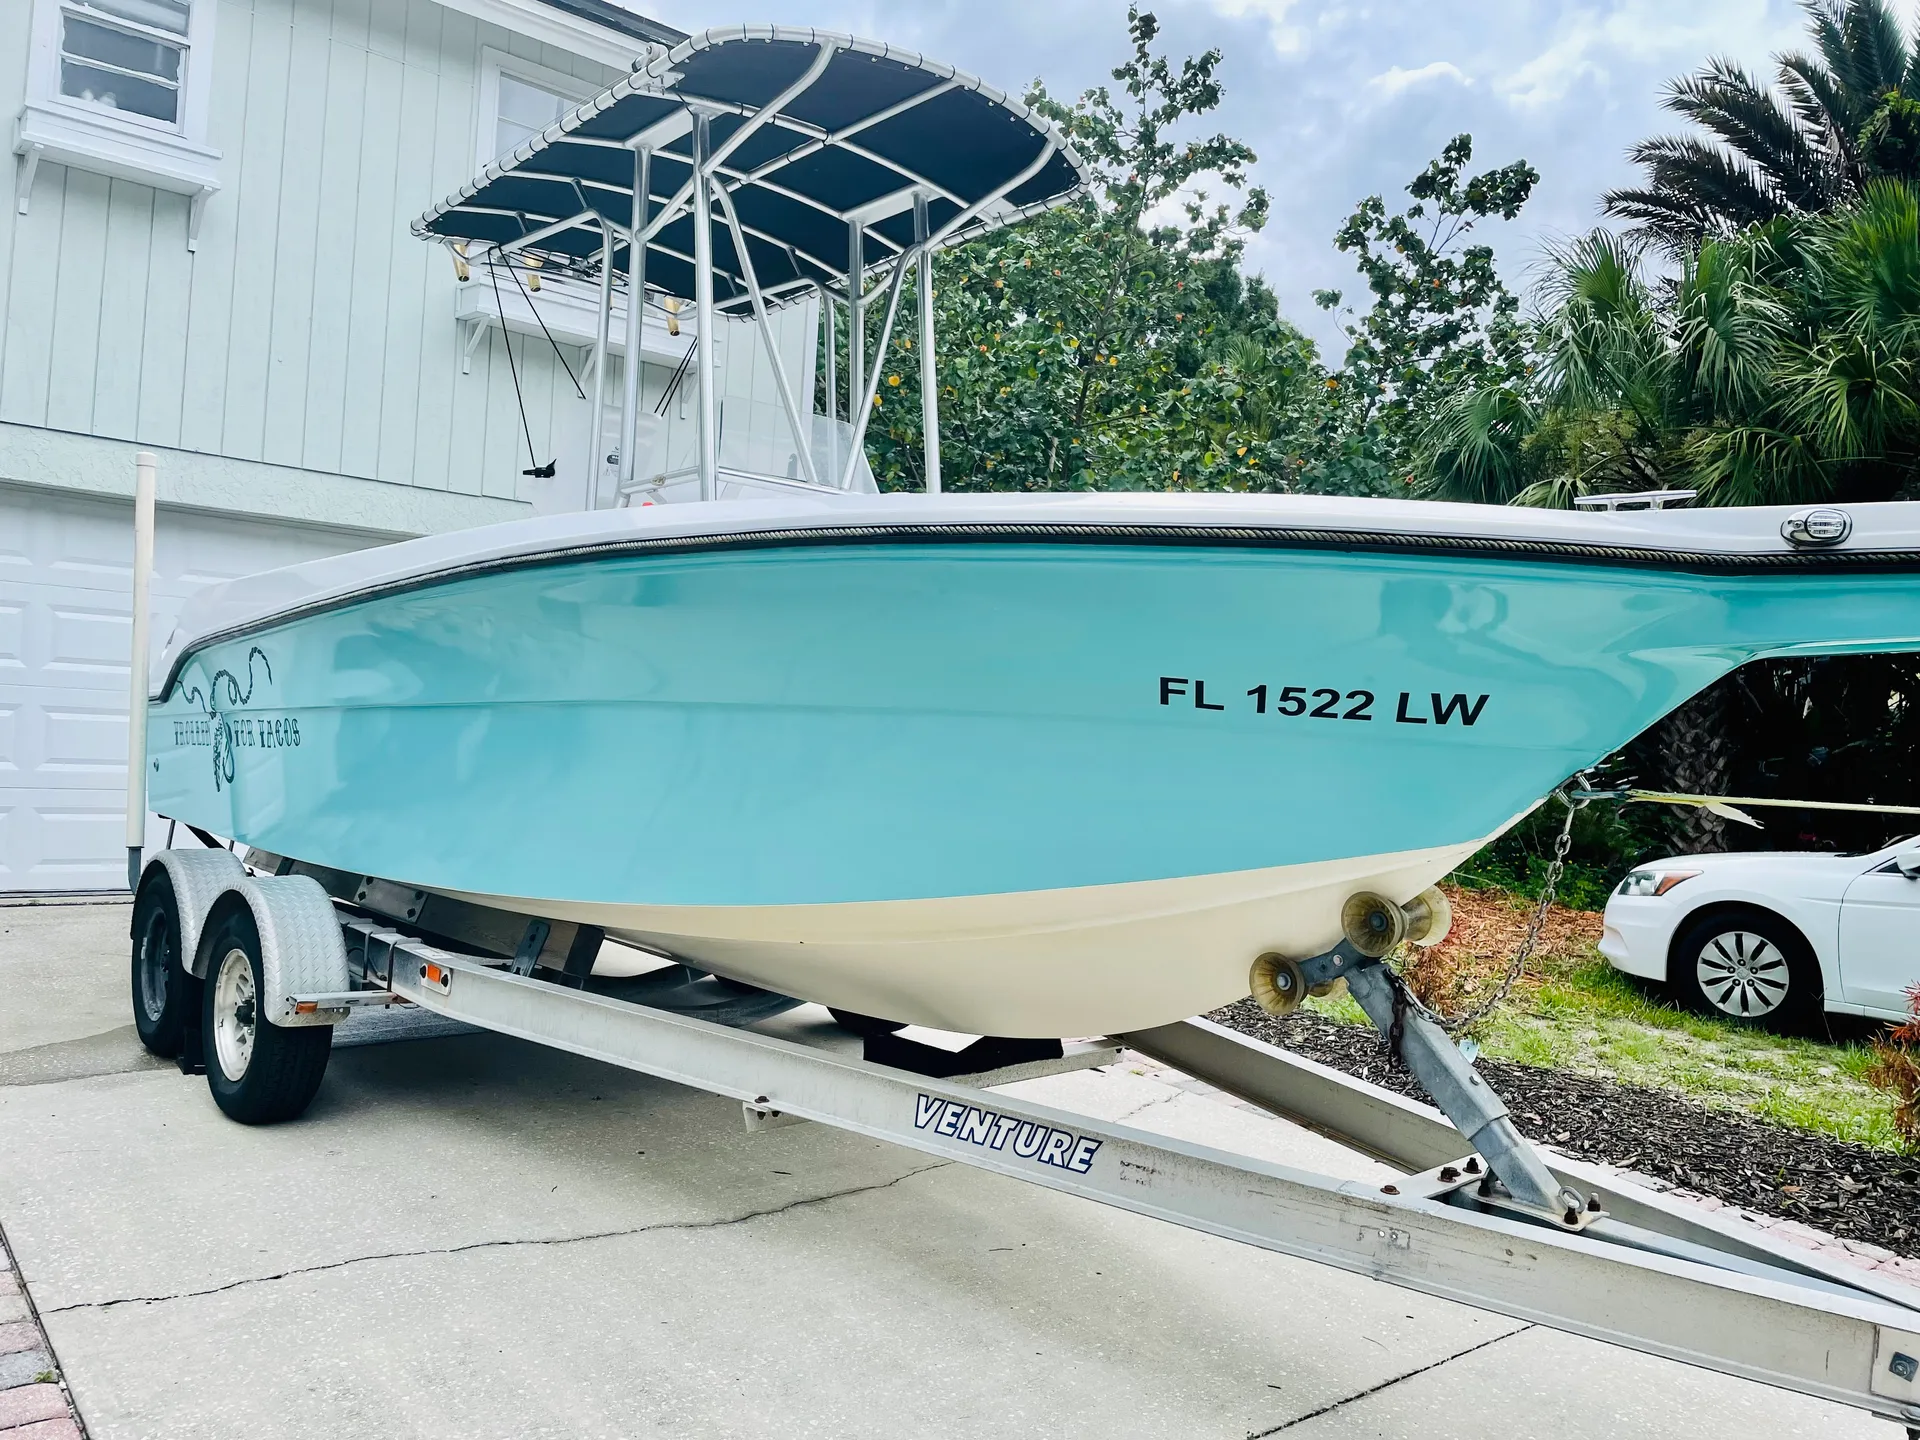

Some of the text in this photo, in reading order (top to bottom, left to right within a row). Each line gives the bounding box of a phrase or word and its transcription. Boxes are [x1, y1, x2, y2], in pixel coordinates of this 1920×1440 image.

[1159, 676, 1491, 726] FL 1522 LW
[233, 719, 256, 747] FOR
[257, 718, 301, 748] TACOS
[915, 1093, 1103, 1174] VENTURE
